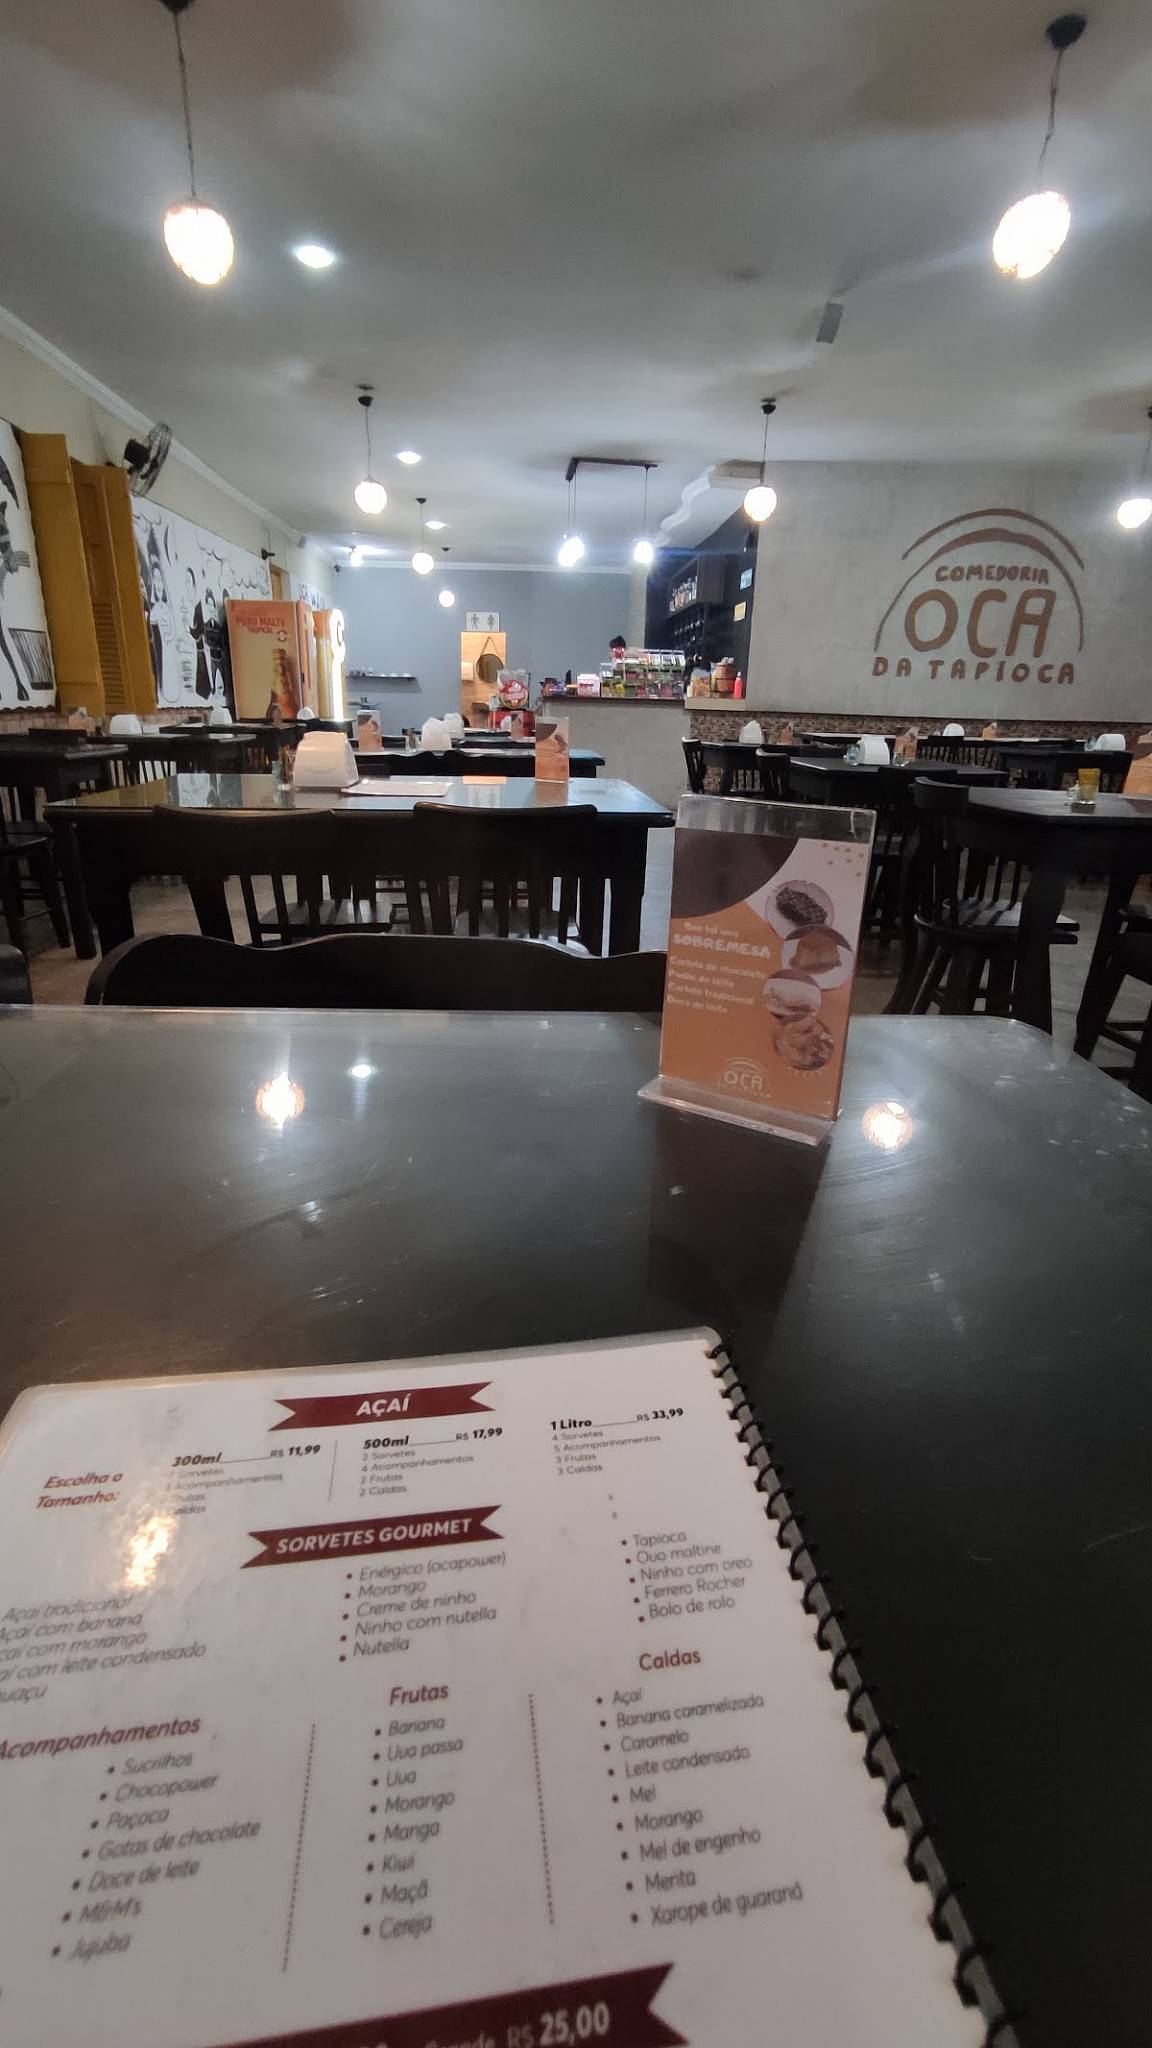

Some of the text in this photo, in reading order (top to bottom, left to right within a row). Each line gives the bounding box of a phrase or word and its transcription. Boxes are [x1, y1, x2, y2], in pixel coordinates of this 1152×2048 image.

[935, 565, 1049, 584] COMEDORIA
[904, 588, 1057, 658] OCA
[872, 656, 1075, 684] DA TAPIOCA
[673, 934, 770, 958] SOBREMESA
[724, 1070, 763, 1091] OCA
[356, 1393, 410, 1418] AÇAÍ
[550, 1408, 684, 1430] 1 Litro R$ 33,99
[363, 1427, 503, 1450] 500ml R$ 17,99
[552, 1429, 604, 1442] 4 Sorvetes
[562, 1434, 661, 1454] Acompanhamentos
[172, 1445, 321, 1468] 300ml R$ 11,99
[361, 1454, 474, 1473] 4 Acompanhamentos
[372, 1448, 416, 1460] Sorvetes
[564, 1452, 597, 1463] Frutas
[44, 1471, 123, 1490] Escolha o
[369, 1473, 403, 1485] Frutas
[566, 1463, 603, 1475] Caldas
[37, 1490, 120, 1510] Tamanho:
[368, 1484, 407, 1497] Caldas
[173, 1505, 207, 1517] aldas
[277, 1517, 472, 1554] SORVETES GOURMET
[634, 1529, 687, 1549] Tapioca
[670, 1542, 722, 1561] maltine
[359, 1551, 506, 1583] Enérgico (ocapower)
[640, 1557, 753, 1582] Ninho com oreo
[358, 1580, 426, 1599] Morango
[644, 1574, 746, 1598] Ferrero Rocher
[357, 1590, 477, 1618] Creme de ninho
[649, 1595, 736, 1619] Bolo de rolo
[35, 1622, 74, 1638] com
[77, 1613, 144, 1633] banana
[355, 1606, 497, 1637] Ninho com nutella
[0, 1631, 148, 1661] çaí com morango
[353, 1638, 410, 1657] Nutella
[17, 1662, 58, 1681] com
[61, 1656, 100, 1675] leite
[100, 1639, 207, 1670] condensado
[639, 1649, 701, 1671] Caldas
[389, 1682, 449, 1707] Frutas
[616, 1692, 765, 1729] Banana caramelizada
[388, 1716, 446, 1737] Banana
[0, 1717, 201, 1761] Acompanhamentos
[420, 1736, 464, 1759] passa
[620, 1730, 690, 1753] Caramelo
[122, 1753, 193, 1777] Sucrilhos
[625, 1744, 751, 1779] Leite condensado
[384, 1789, 455, 1816] Morango
[629, 1786, 656, 1804] Mel
[106, 1808, 170, 1832] Paçoca
[634, 1808, 703, 1833] Morango
[98, 1820, 261, 1862] Gotas de chocolate
[383, 1818, 440, 1847] Manga
[640, 1826, 761, 1862] Mel de engenho
[88, 1859, 201, 1893] Doce de leite
[645, 1869, 697, 1894] Menta
[380, 1880, 429, 1907] Maçã
[651, 1882, 803, 1930] Xarope de guaraná
[379, 1915, 432, 1943] Cereja
[540, 2001, 610, 2046] 25,00
